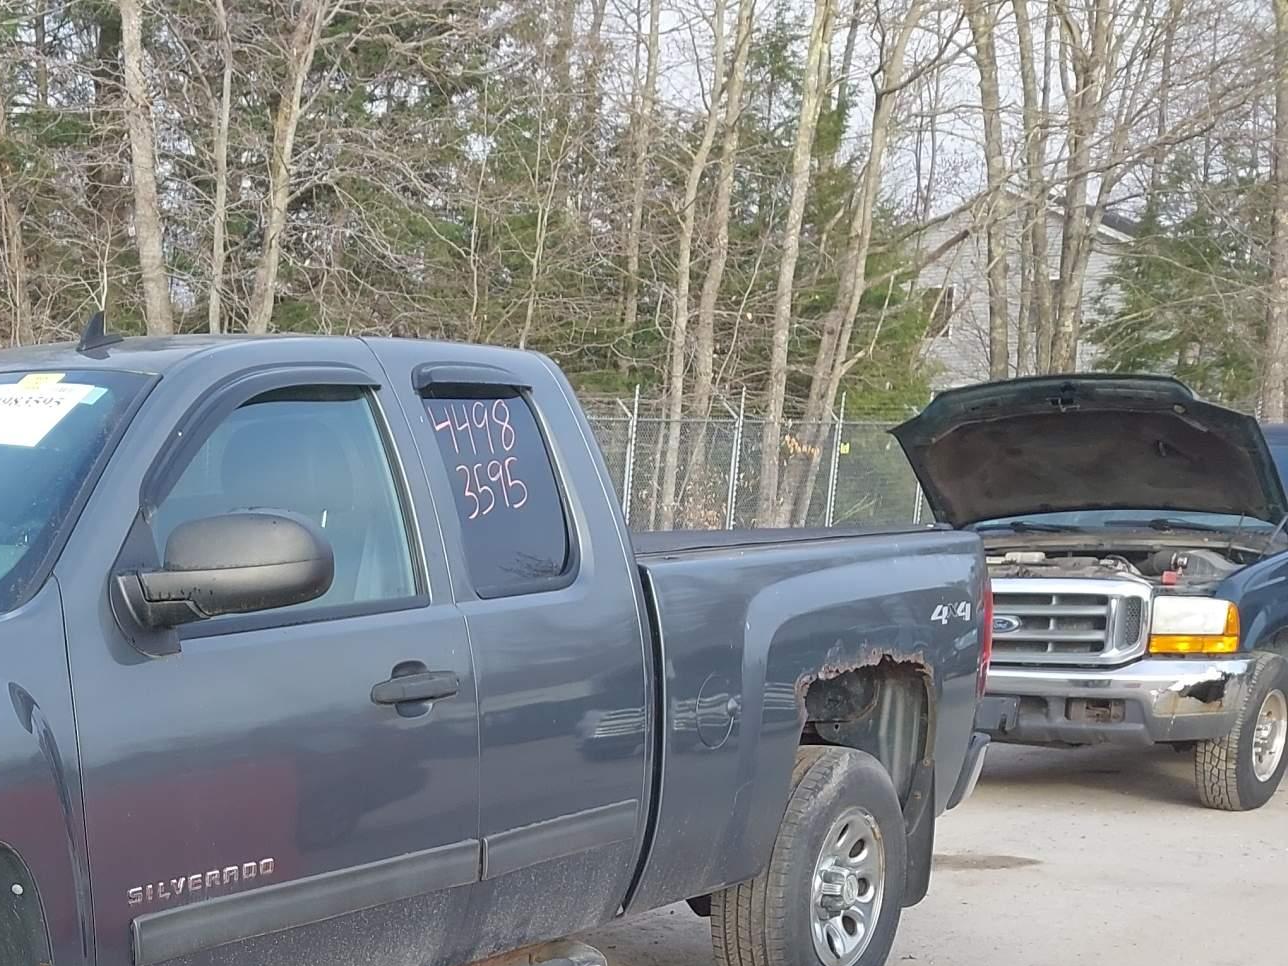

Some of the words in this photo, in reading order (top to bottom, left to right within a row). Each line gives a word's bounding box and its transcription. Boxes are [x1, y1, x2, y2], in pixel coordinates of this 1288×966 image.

[427, 398, 515, 455] 4498
[455, 457, 528, 519] 3595
[128, 857, 275, 905] SILVERADO
